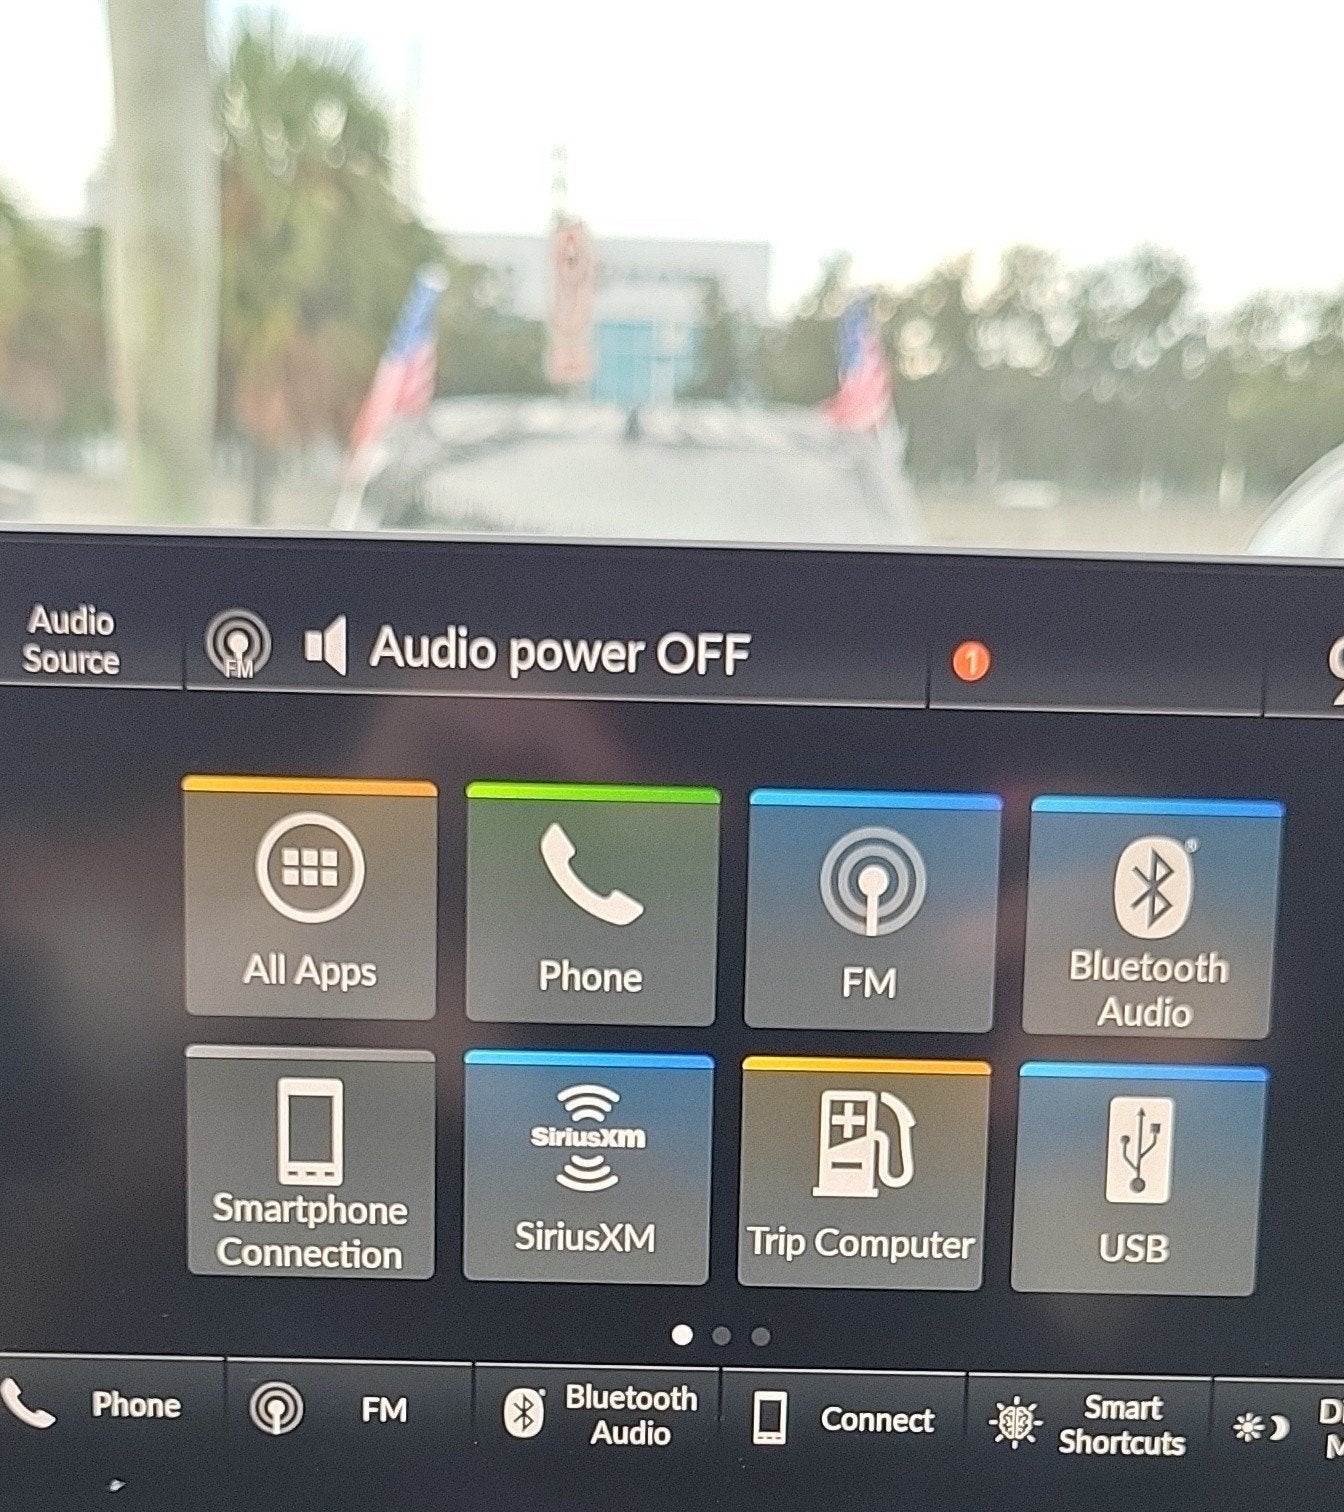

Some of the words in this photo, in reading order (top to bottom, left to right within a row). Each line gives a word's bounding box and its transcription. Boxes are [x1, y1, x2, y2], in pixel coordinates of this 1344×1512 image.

[27, 604, 115, 637] Audio
[22, 643, 121, 677] Source
[369, 624, 498, 671] Audio
[510, 632, 646, 679] power
[656, 631, 752, 676] OFF
[225, 659, 254, 679] FM
[242, 954, 287, 987] All
[293, 957, 378, 991] Apps
[538, 960, 644, 993] Phone
[842, 967, 897, 999] FM
[1068, 950, 1229, 985] Bluetooth
[1097, 998, 1193, 1031] Audio
[212, 1192, 408, 1229] Smartphone
[216, 1237, 403, 1270] Connection
[514, 1221, 656, 1254] SiriusXM
[746, 1225, 806, 1261] Trip
[813, 1228, 976, 1263] Computer
[1099, 1233, 1170, 1264] USB
[92, 1391, 182, 1420] Phone
[362, 1397, 408, 1424] FM
[565, 1384, 699, 1413] Bluetooth
[1084, 1395, 1164, 1422] Smart
[590, 1420, 671, 1447] Audio
[821, 1407, 936, 1434] Connect
[1059, 1430, 1187, 1458] Shortcuts
